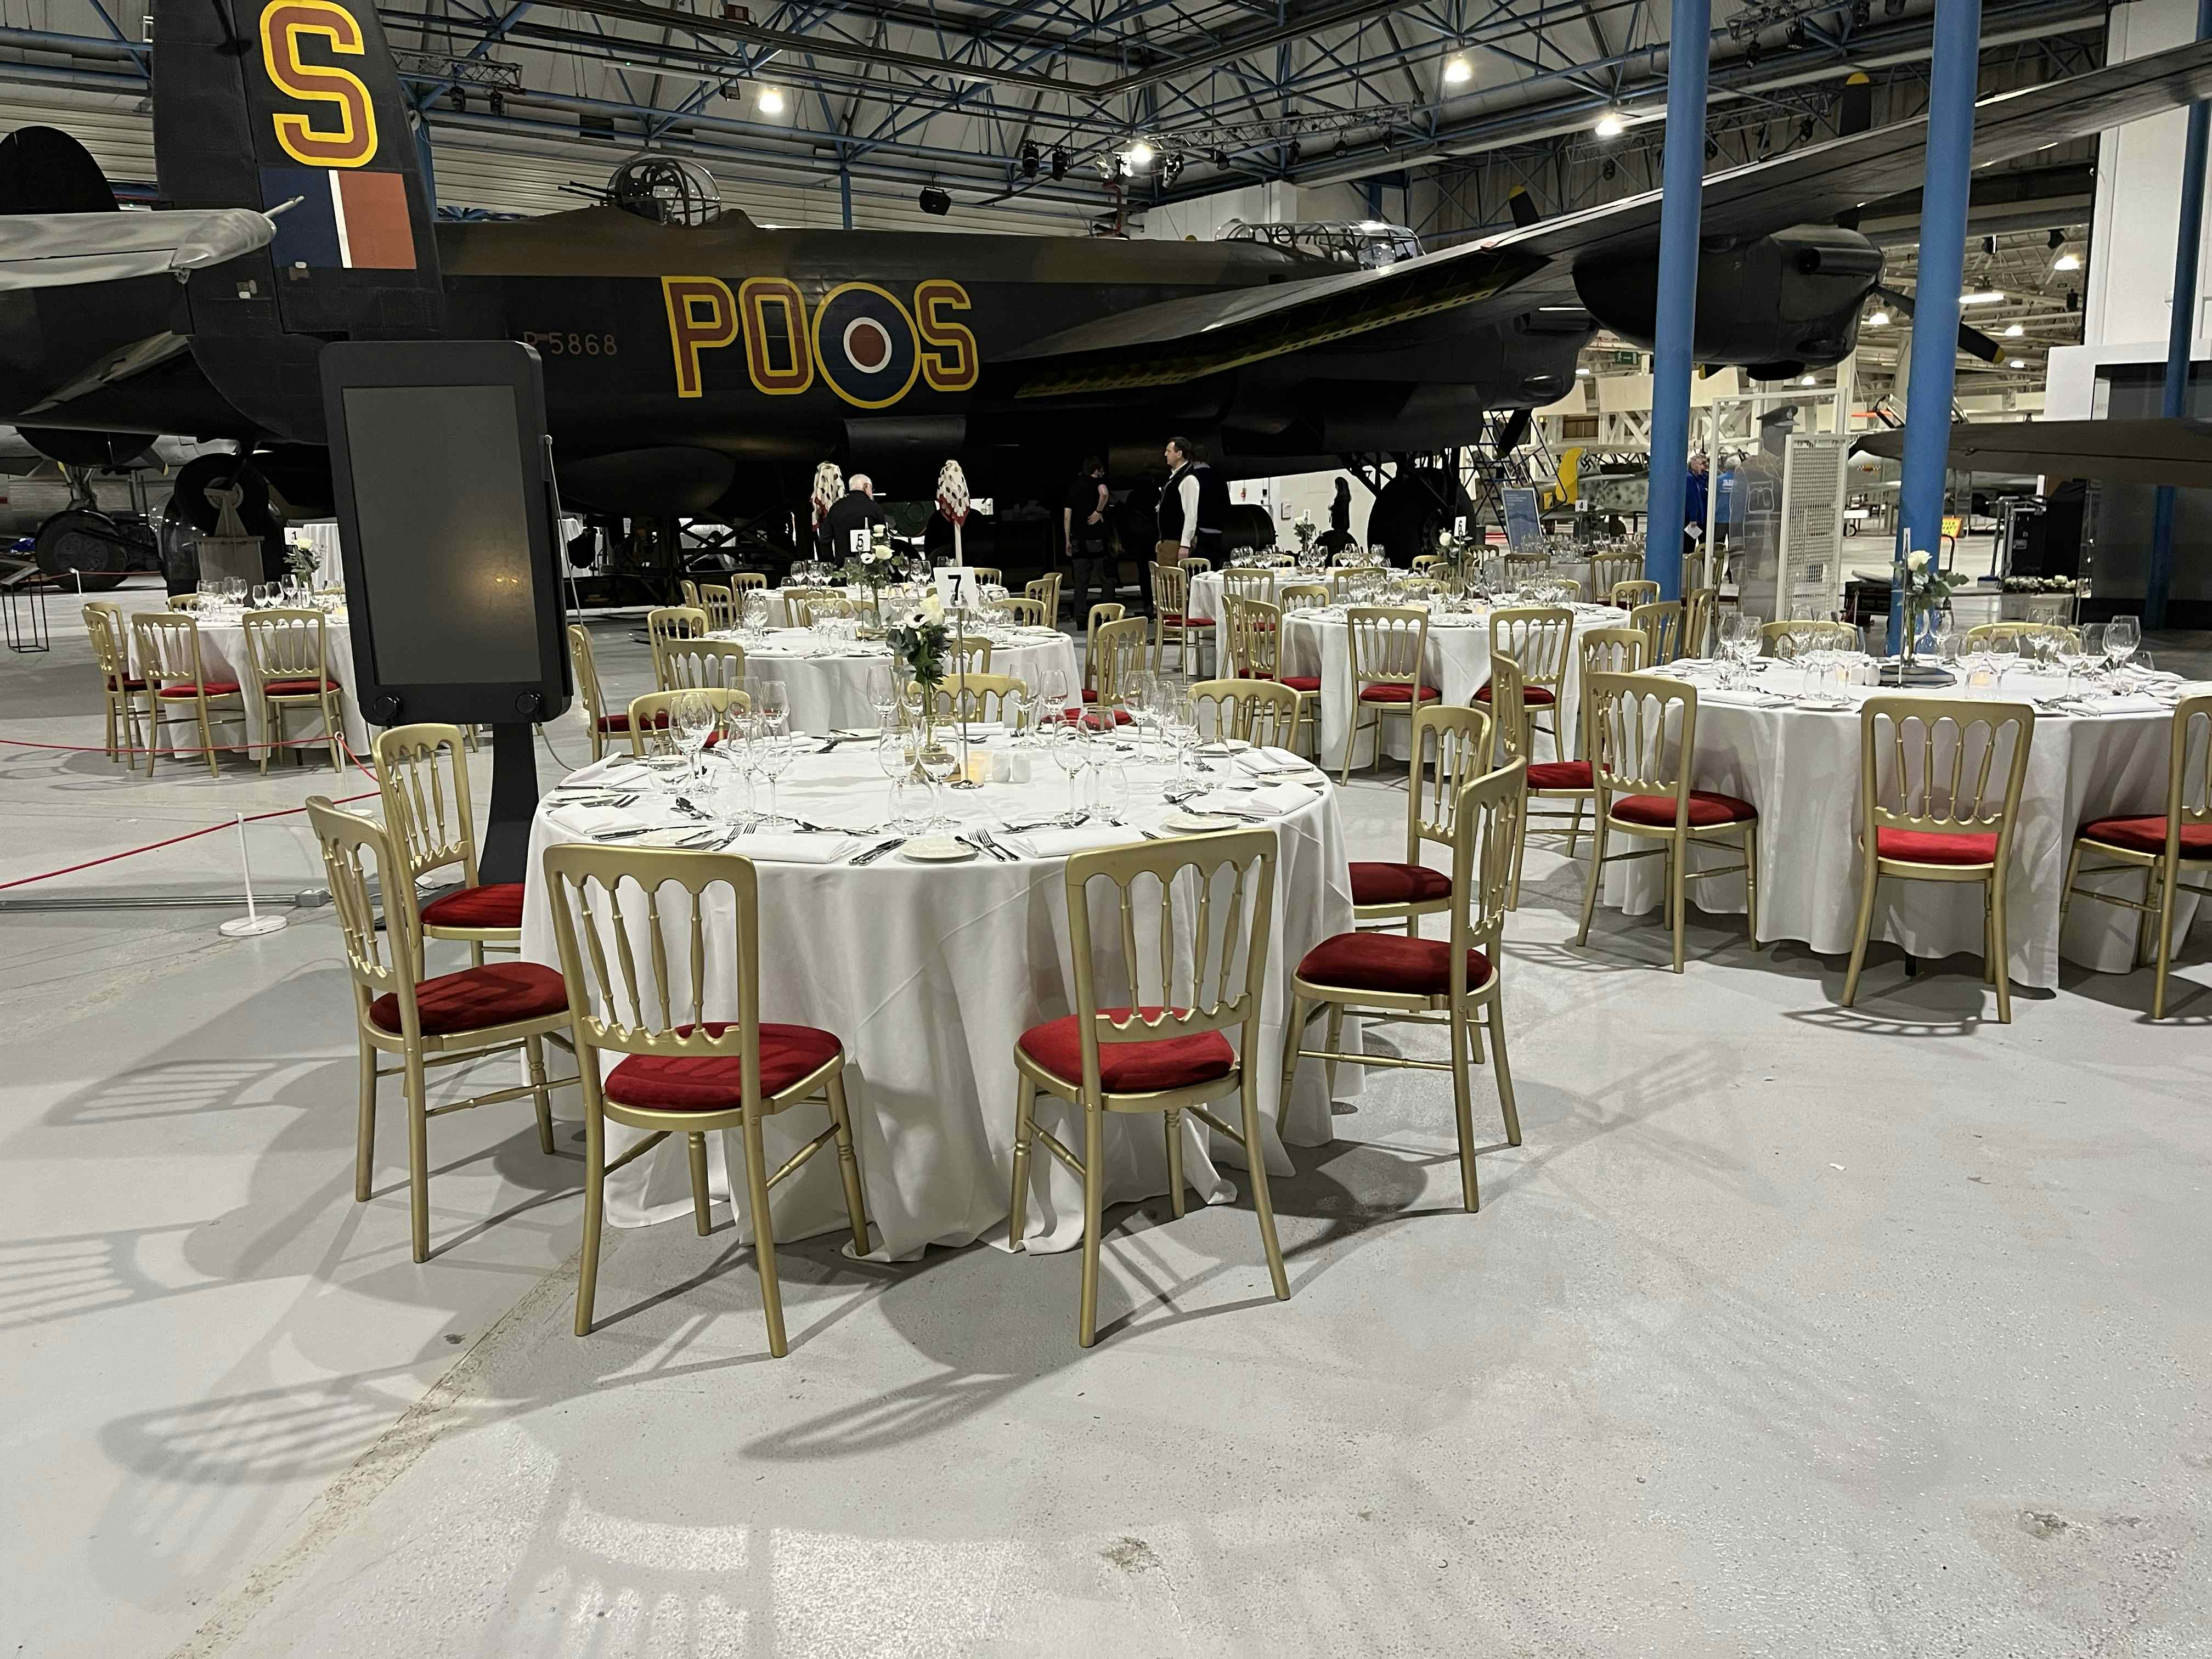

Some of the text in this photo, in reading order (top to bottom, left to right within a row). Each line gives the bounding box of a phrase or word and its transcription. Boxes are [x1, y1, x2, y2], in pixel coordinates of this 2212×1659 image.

[259, 0, 378, 167] S
[292, 531, 297, 540] 1
[857, 533, 864, 548] 5
[948, 574, 961, 601] 7
